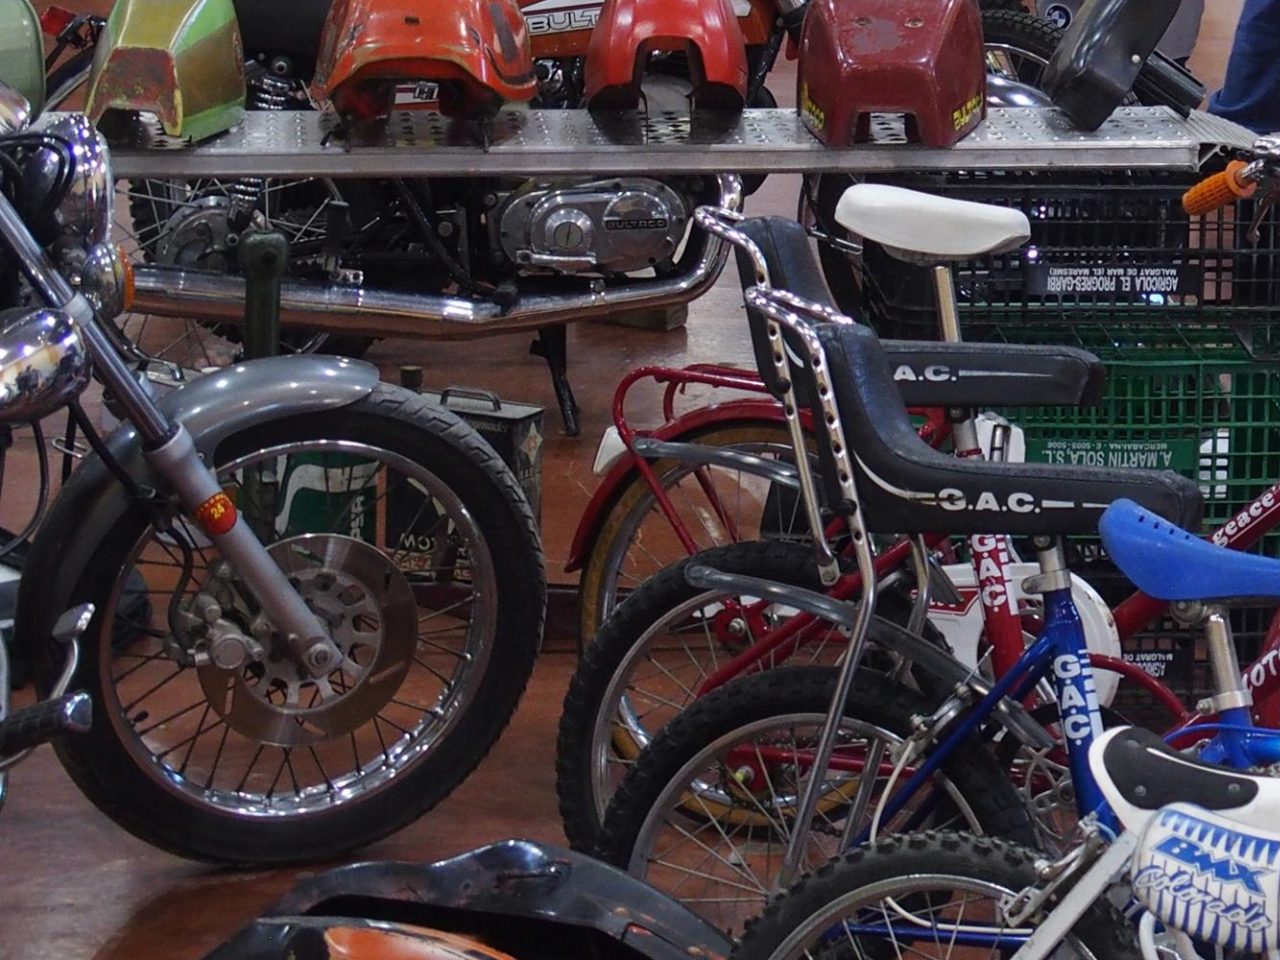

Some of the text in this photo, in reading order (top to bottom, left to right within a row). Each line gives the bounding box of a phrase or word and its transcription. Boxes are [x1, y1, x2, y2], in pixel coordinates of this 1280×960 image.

[526, 8, 602, 33] BULT
[1049, 268, 1177, 276] MALGRAT DE MAR (EL MARESME)
[1120, 276, 1131, 291] EL
[1135, 276, 1178, 291] AGRICOLA
[893, 364, 957, 381] A.C.
[211, 503, 225, 519] 24
[938, 487, 1041, 513] G.A.C.
[971, 534, 1007, 613] G.A.C.
[1053, 653, 1091, 746] G.A.C.
[1153, 834, 1276, 897] BMX
[1133, 865, 1273, 932] Colorado
